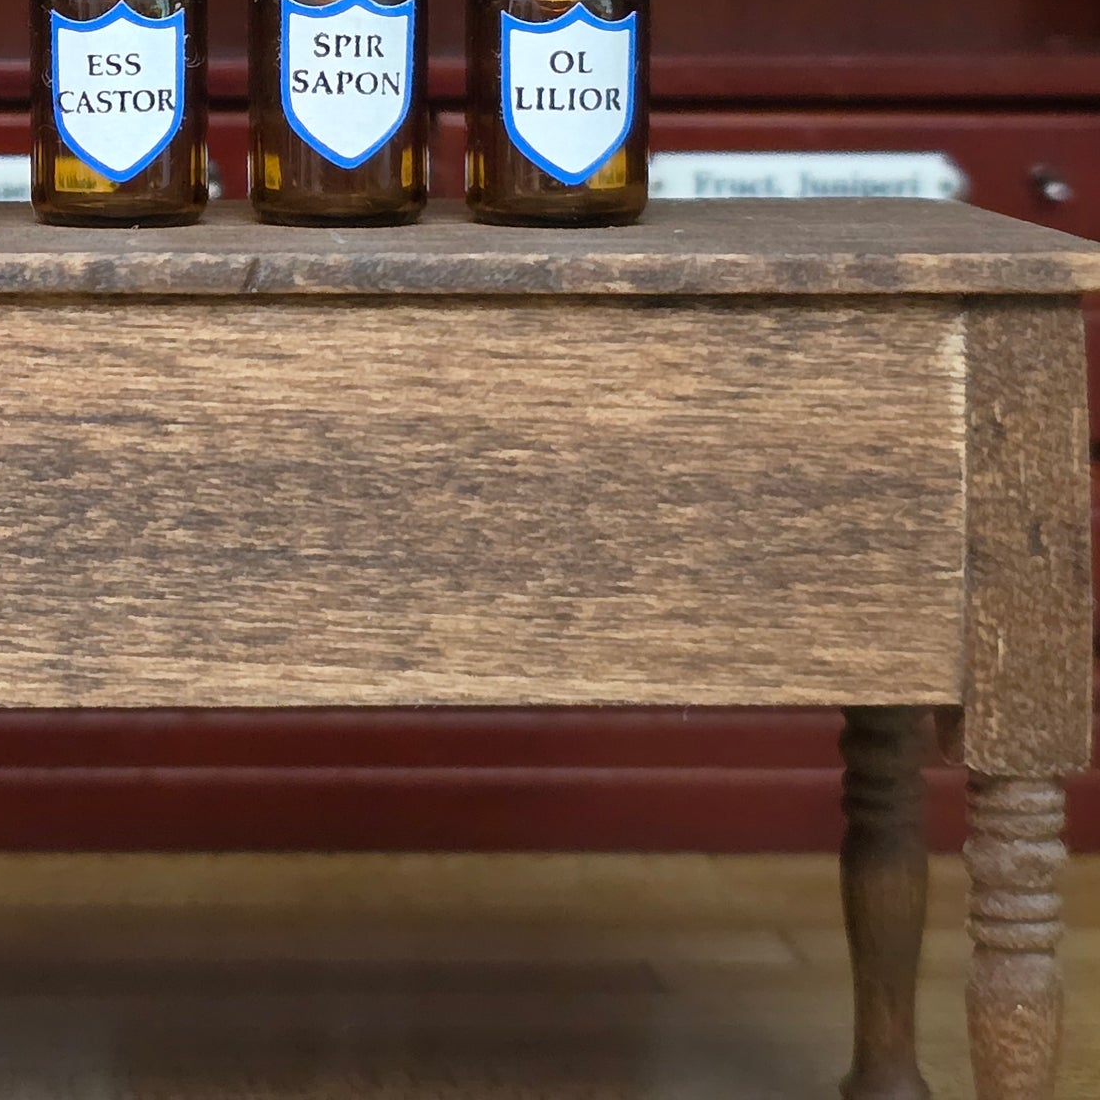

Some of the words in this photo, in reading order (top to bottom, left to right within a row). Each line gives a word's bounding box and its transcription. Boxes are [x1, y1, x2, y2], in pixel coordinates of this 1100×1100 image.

[313, 31, 385, 59] SPIR
[86, 53, 142, 77] ESS
[549, 50, 593, 75] OL
[291, 69, 401, 97] SAPON
[57, 88, 175, 114] CASTOR
[515, 86, 622, 112] LILIOR
